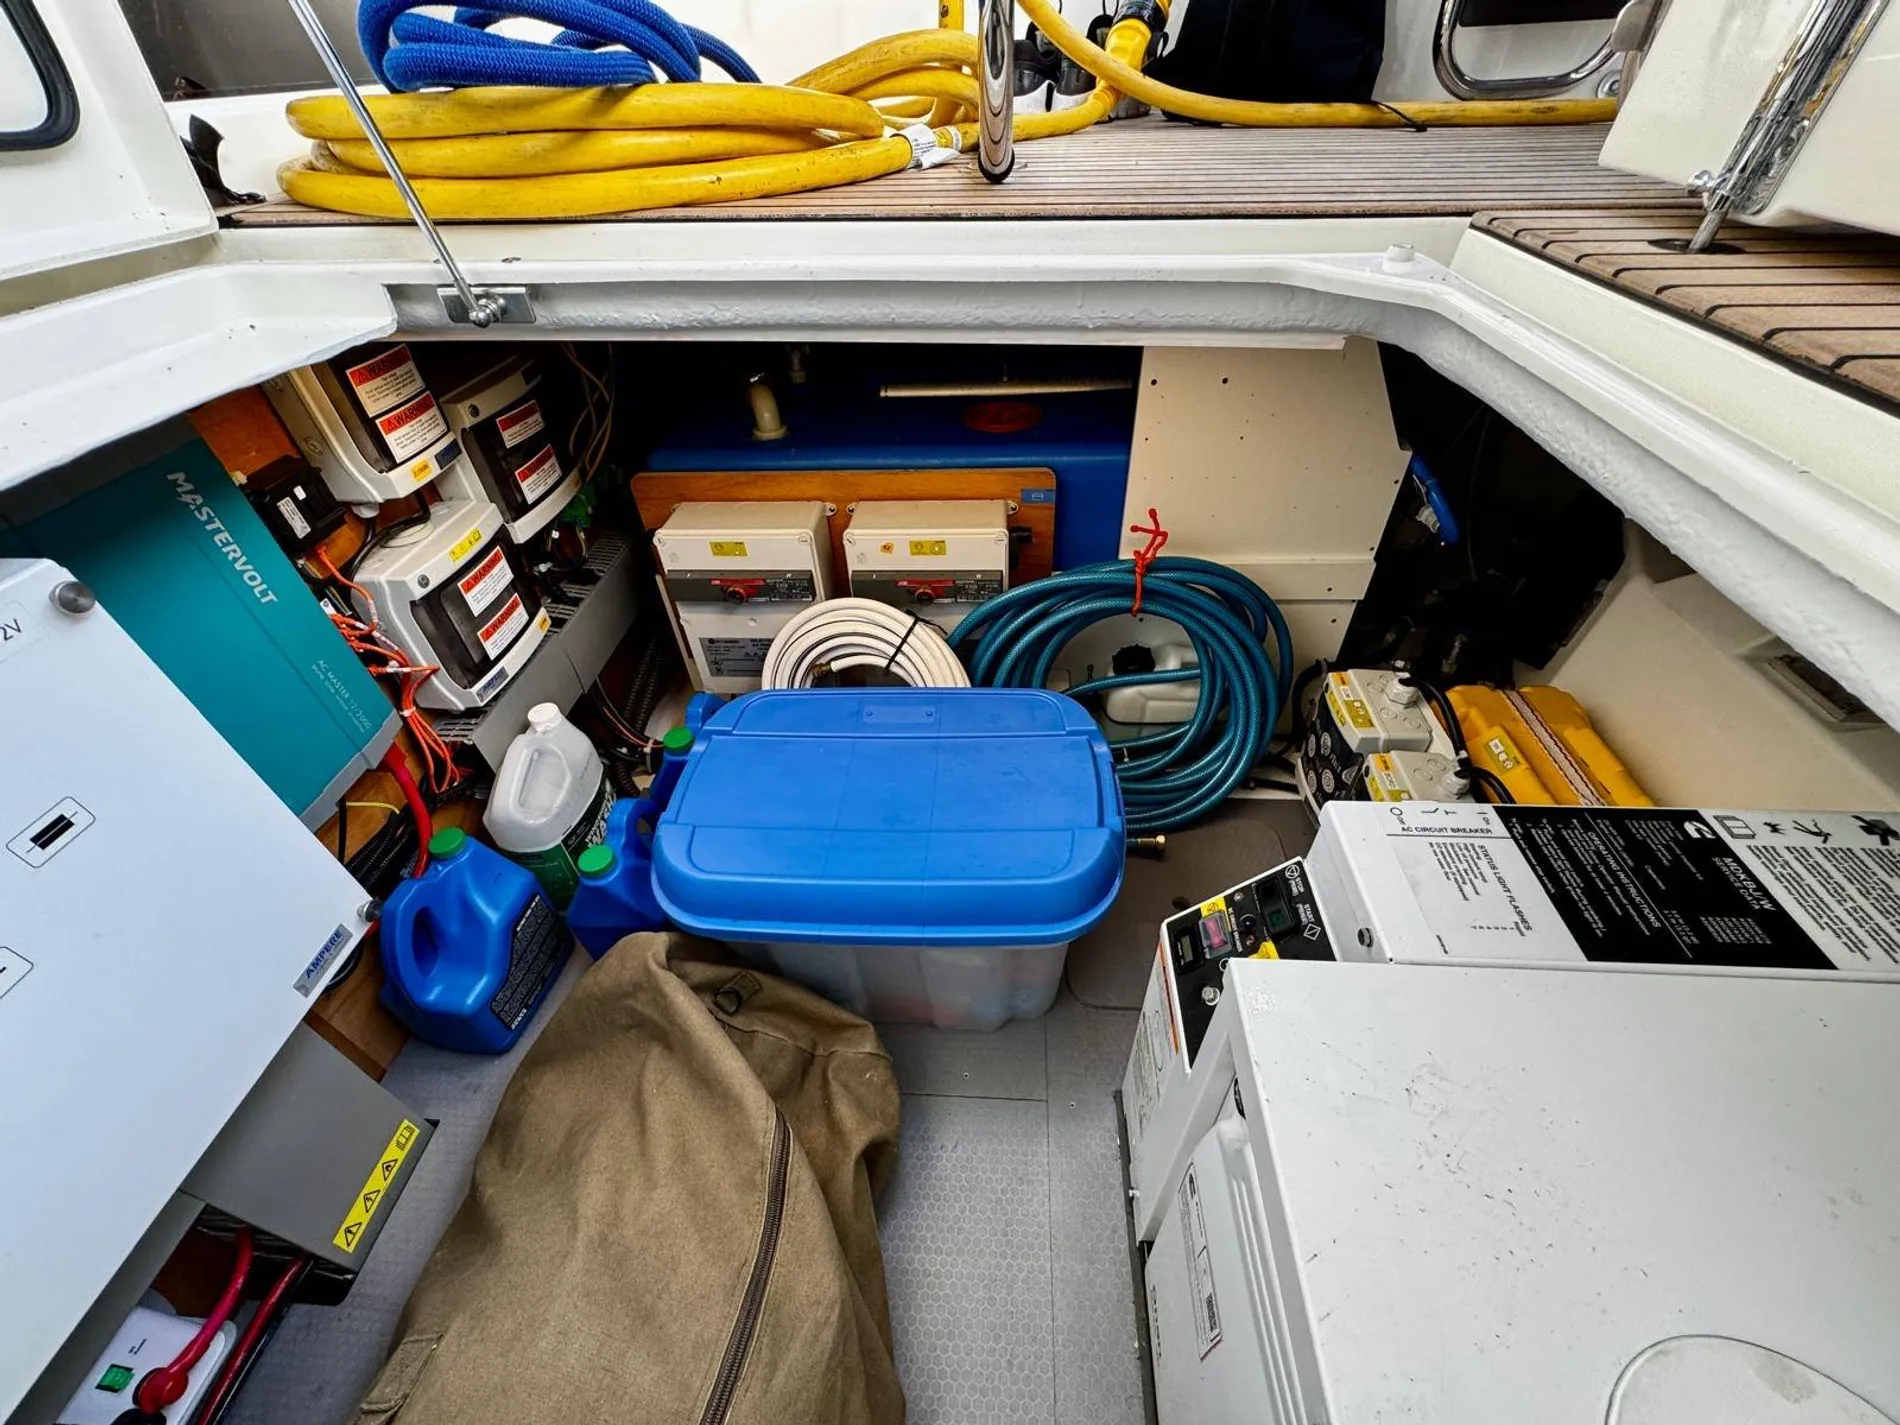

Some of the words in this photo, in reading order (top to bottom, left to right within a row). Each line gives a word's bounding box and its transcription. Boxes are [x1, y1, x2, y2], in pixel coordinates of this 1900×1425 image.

[166, 471, 278, 604] MASTERVOLT
[470, 552, 501, 584] WARNING
[489, 599, 520, 632] WARNING
[1293, 876, 1305, 893] STOP
[1476, 844, 1498, 870] STATUS
[1492, 872, 1511, 893] LIGHT
[1506, 895, 1533, 931] FLASHES
[1586, 831, 1620, 870] OPERATING
[1614, 871, 1662, 927] INSTRUCTIONS
[1710, 857, 1743, 887] SERVICE
[1737, 888, 1762, 909] DATA
[1719, 857, 1777, 910] MDKBJ/W
[1302, 903, 1316, 922] START
[302, 928, 344, 979] AMPERE
